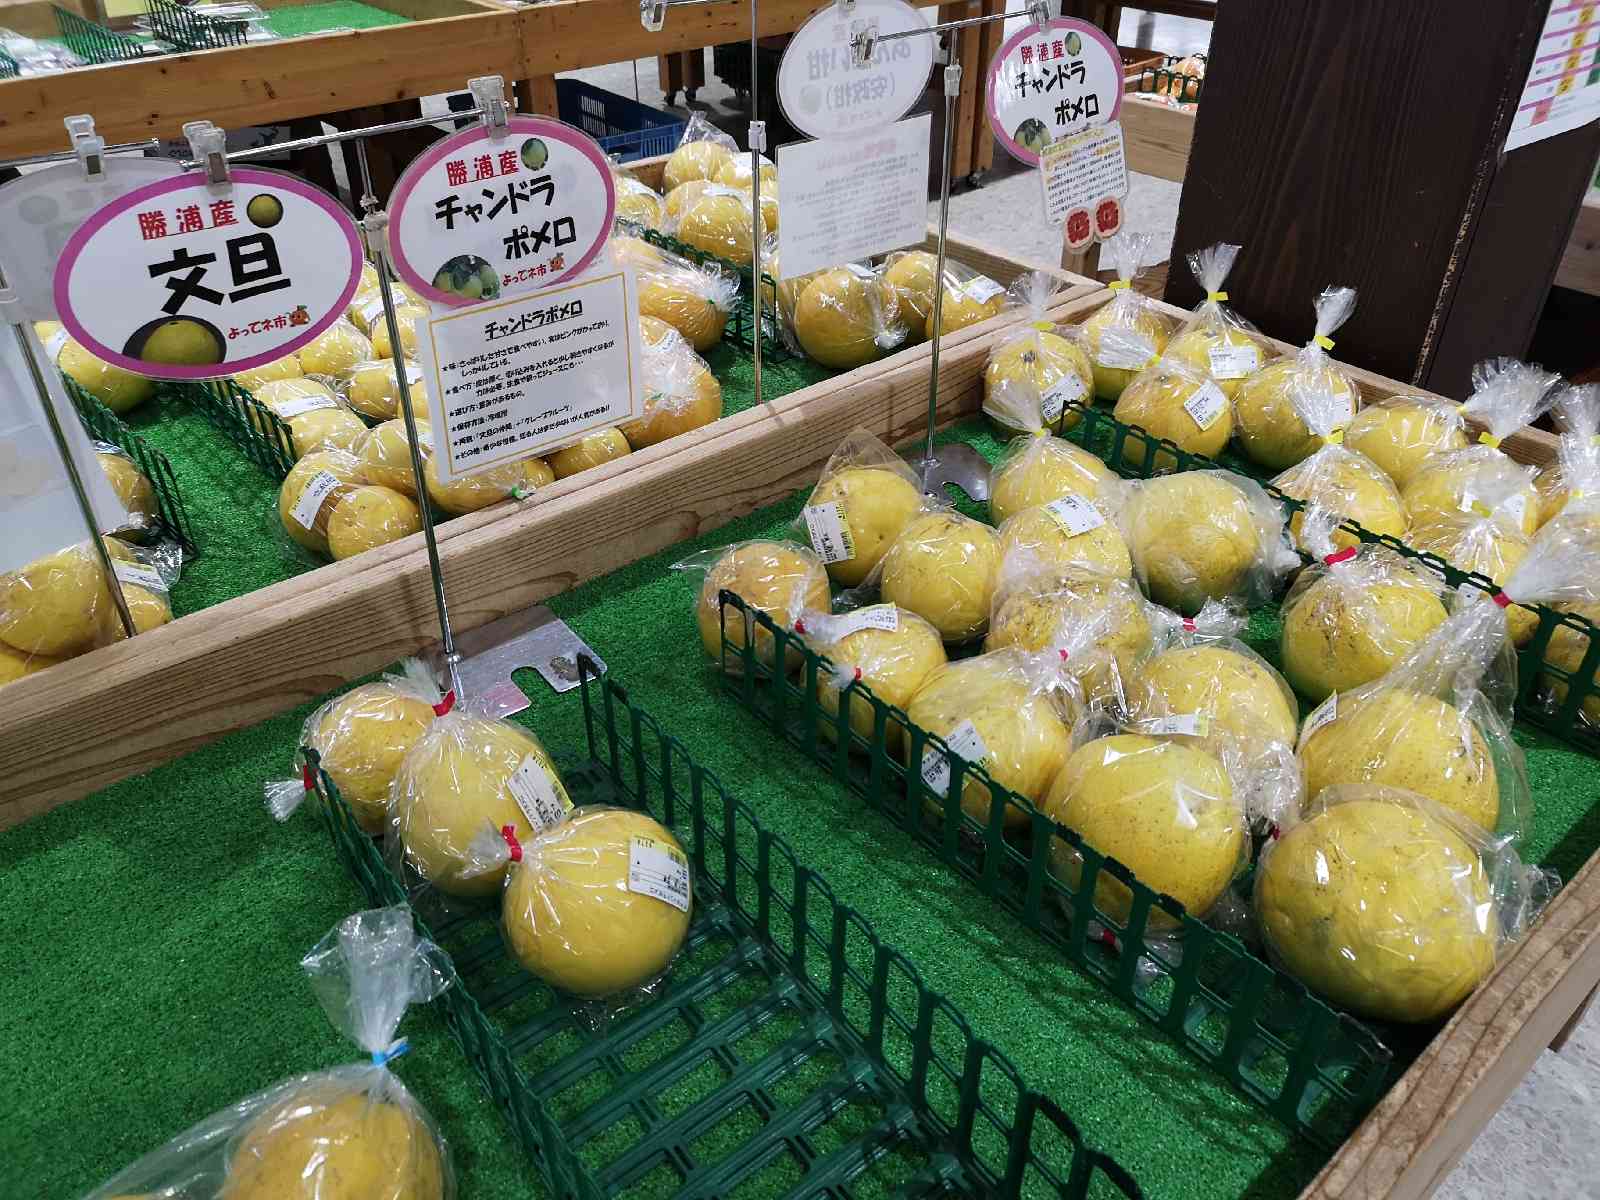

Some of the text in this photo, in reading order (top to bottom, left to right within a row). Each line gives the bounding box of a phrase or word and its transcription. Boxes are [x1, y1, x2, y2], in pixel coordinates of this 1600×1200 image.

[1015, 60, 1086, 98] チャンドラ
[1054, 93, 1100, 125] ポメロ
[446, 150, 520, 187] 勝浦産
[137, 200, 240, 241] 勝浦産
[434, 174, 555, 230] チャンドラ
[503, 216, 577, 260] ポメロ
[147, 232, 292, 315] 文旦
[502, 262, 547, 287] よってネ市
[227, 315, 288, 340] よってネ市
[484, 299, 583, 340] チャンドラポメロ
